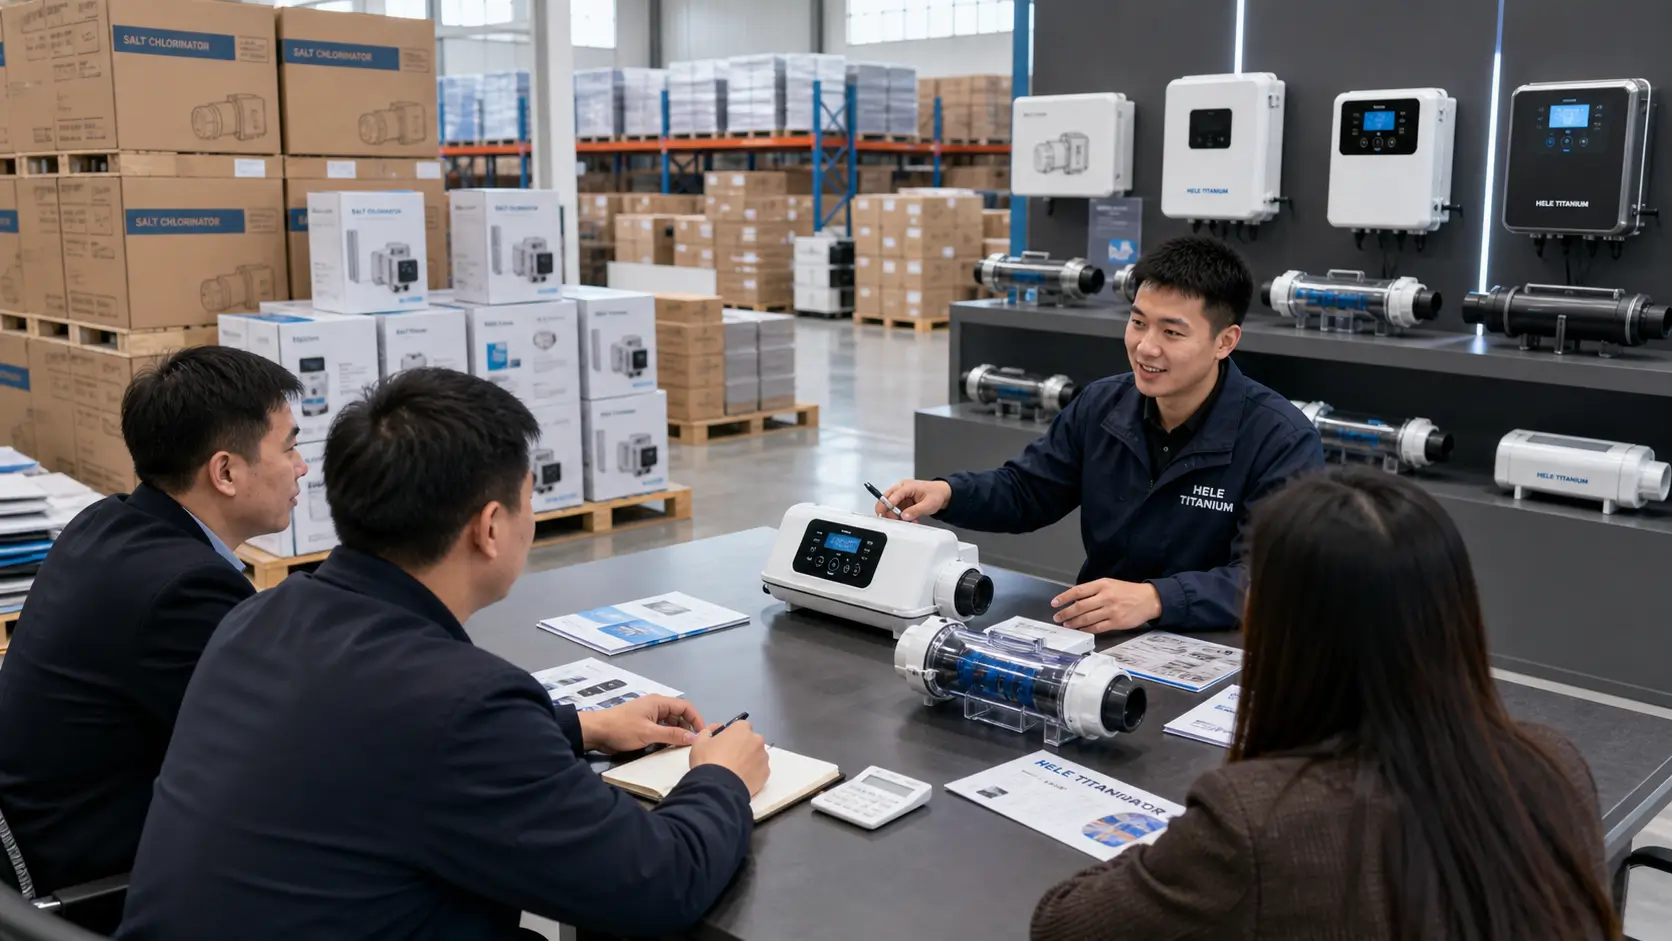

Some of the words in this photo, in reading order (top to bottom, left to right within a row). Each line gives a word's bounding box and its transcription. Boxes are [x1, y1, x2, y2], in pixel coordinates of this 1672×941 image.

[123, 35, 147, 45] SALT
[148, 37, 210, 51] CHLORINATOR
[293, 47, 314, 58] SALT
[315, 49, 373, 62] CHLORINATOR
[1555, 200, 1589, 208] TITANIUM
[135, 217, 158, 227] SALT
[159, 217, 221, 227] CHLORINATOR
[1536, 472, 1554, 480] HELE
[1556, 474, 1589, 485] TITANIUM
[1192, 484, 1225, 499] HELE
[1179, 494, 1234, 513] TITANIUM
[1034, 759, 1076, 778] HELE
